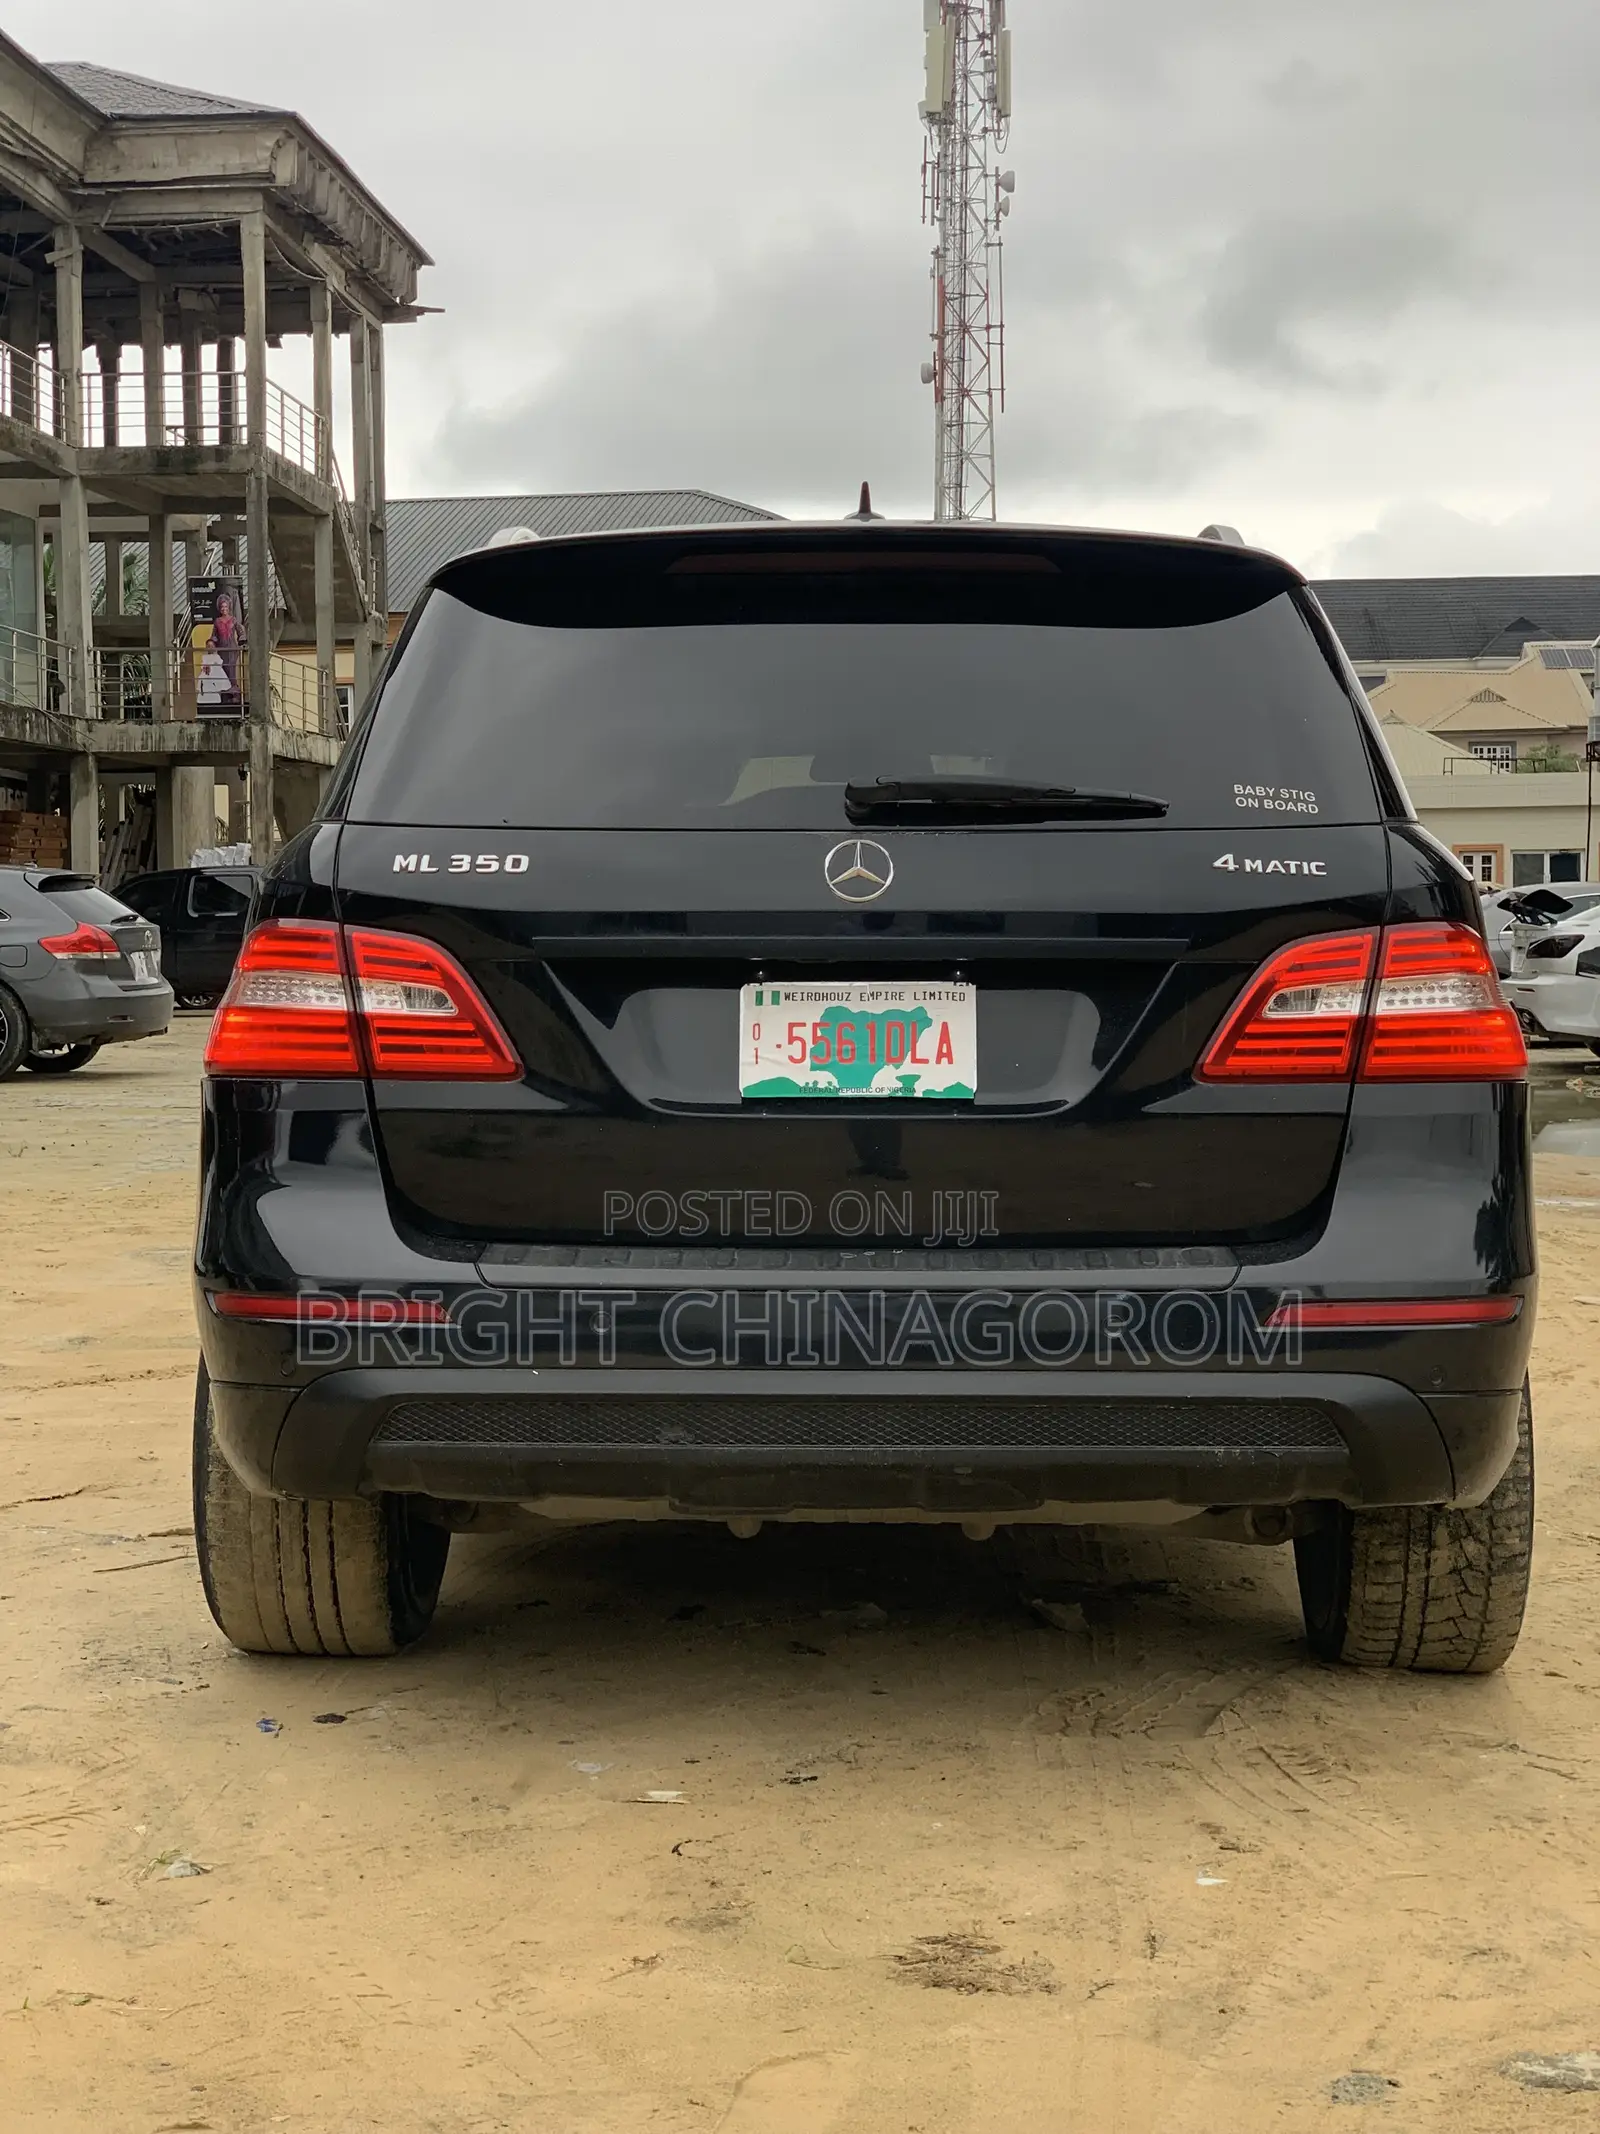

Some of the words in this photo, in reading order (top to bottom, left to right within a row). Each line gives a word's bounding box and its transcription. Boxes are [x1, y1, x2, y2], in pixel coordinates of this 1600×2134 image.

[1234, 784, 1275, 797] BABY
[1279, 788, 1316, 802] STIG
[1235, 797, 1259, 808] ON
[1263, 799, 1319, 814] BOARD
[393, 854, 440, 873] ML
[447, 854, 530, 873] 350
[1212, 853, 1240, 873] 4
[1244, 859, 1328, 876] MATIC
[784, 991, 852, 1002] WEIRDHOUZ
[860, 991, 905, 1002] EMPIRE
[913, 991, 966, 1002] LIMITED
[799, 1086, 833, 1094] FEDERAL
[835, 1086, 873, 1094] REPUBLIC
